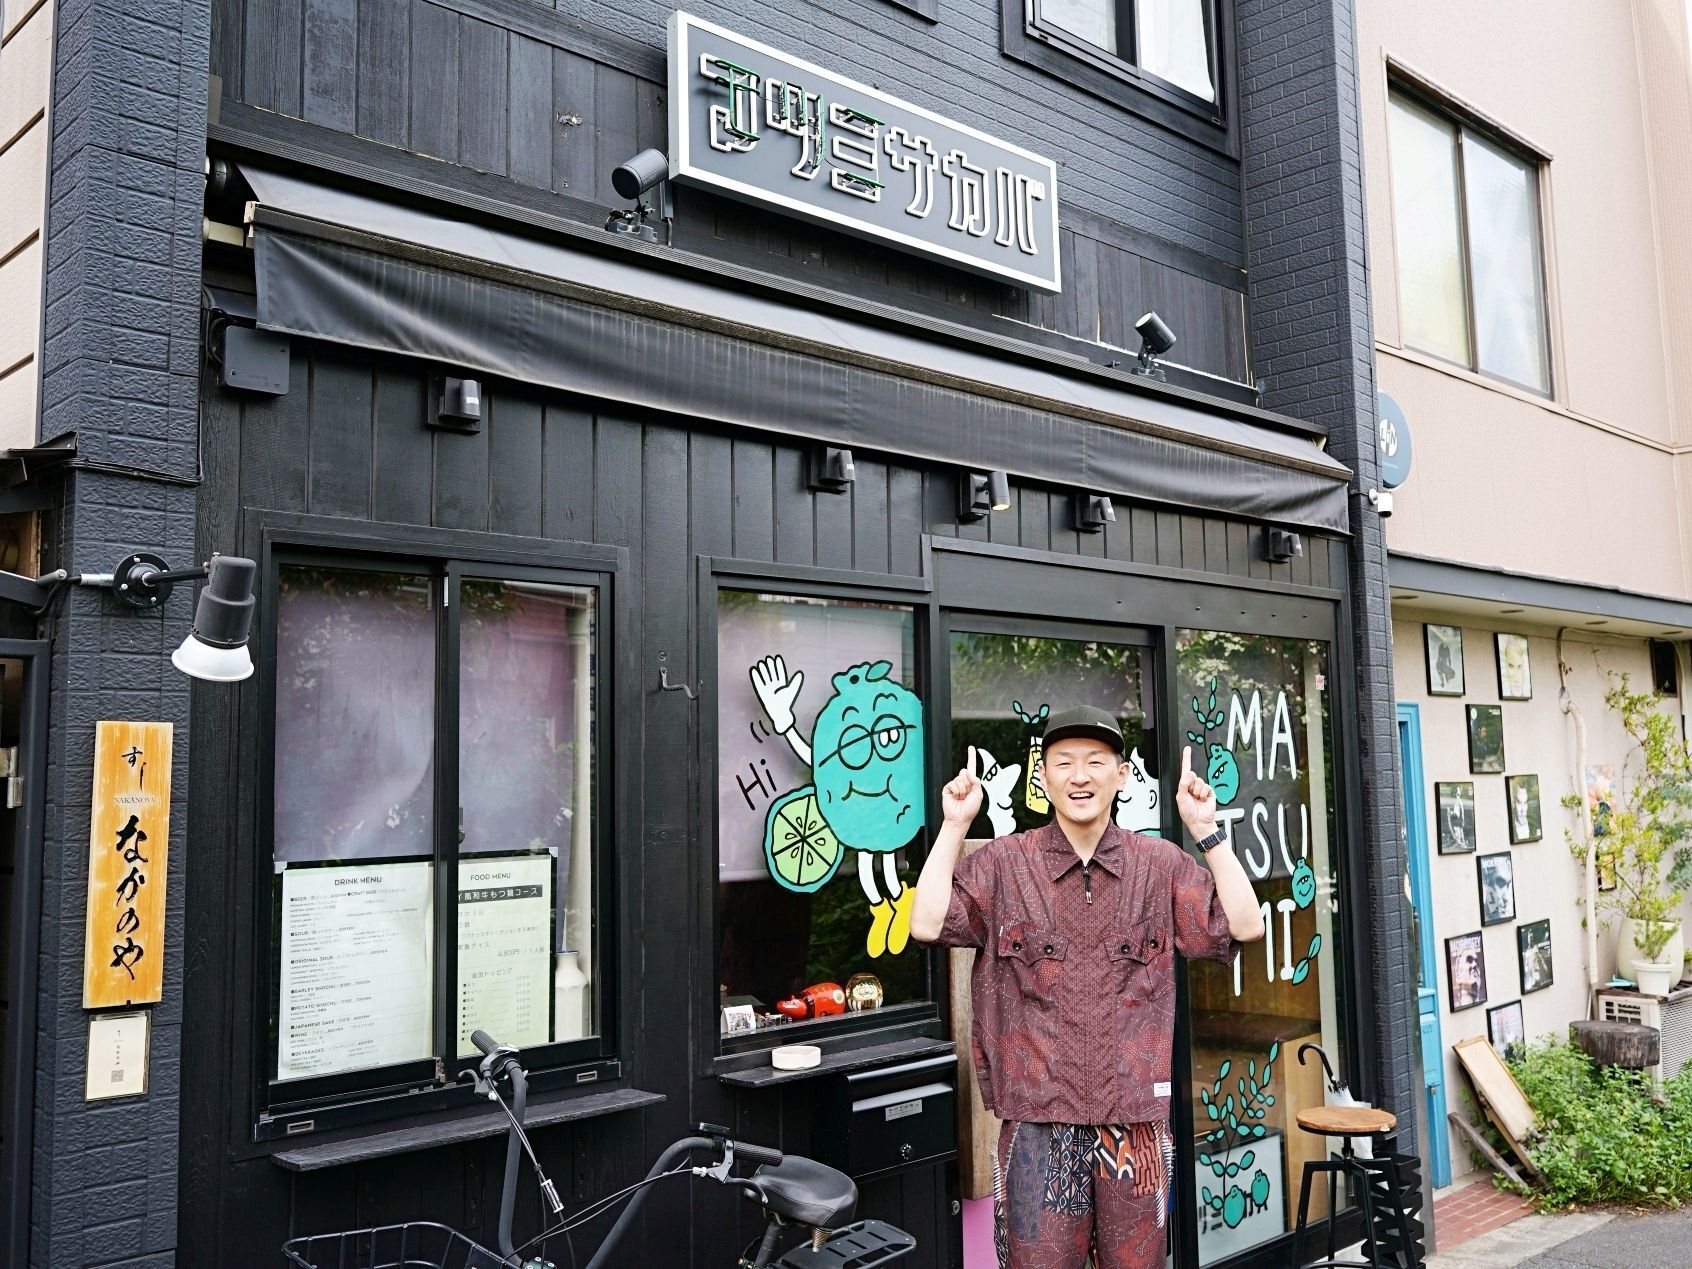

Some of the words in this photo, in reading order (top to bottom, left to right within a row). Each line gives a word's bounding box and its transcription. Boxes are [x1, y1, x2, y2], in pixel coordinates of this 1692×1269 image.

[1226, 690, 1297, 780] MA
[121, 746, 147, 792] すし
[736, 758, 777, 810] Hi
[110, 814, 149, 981] なかのや
[334, 878, 358, 886] DRINK
